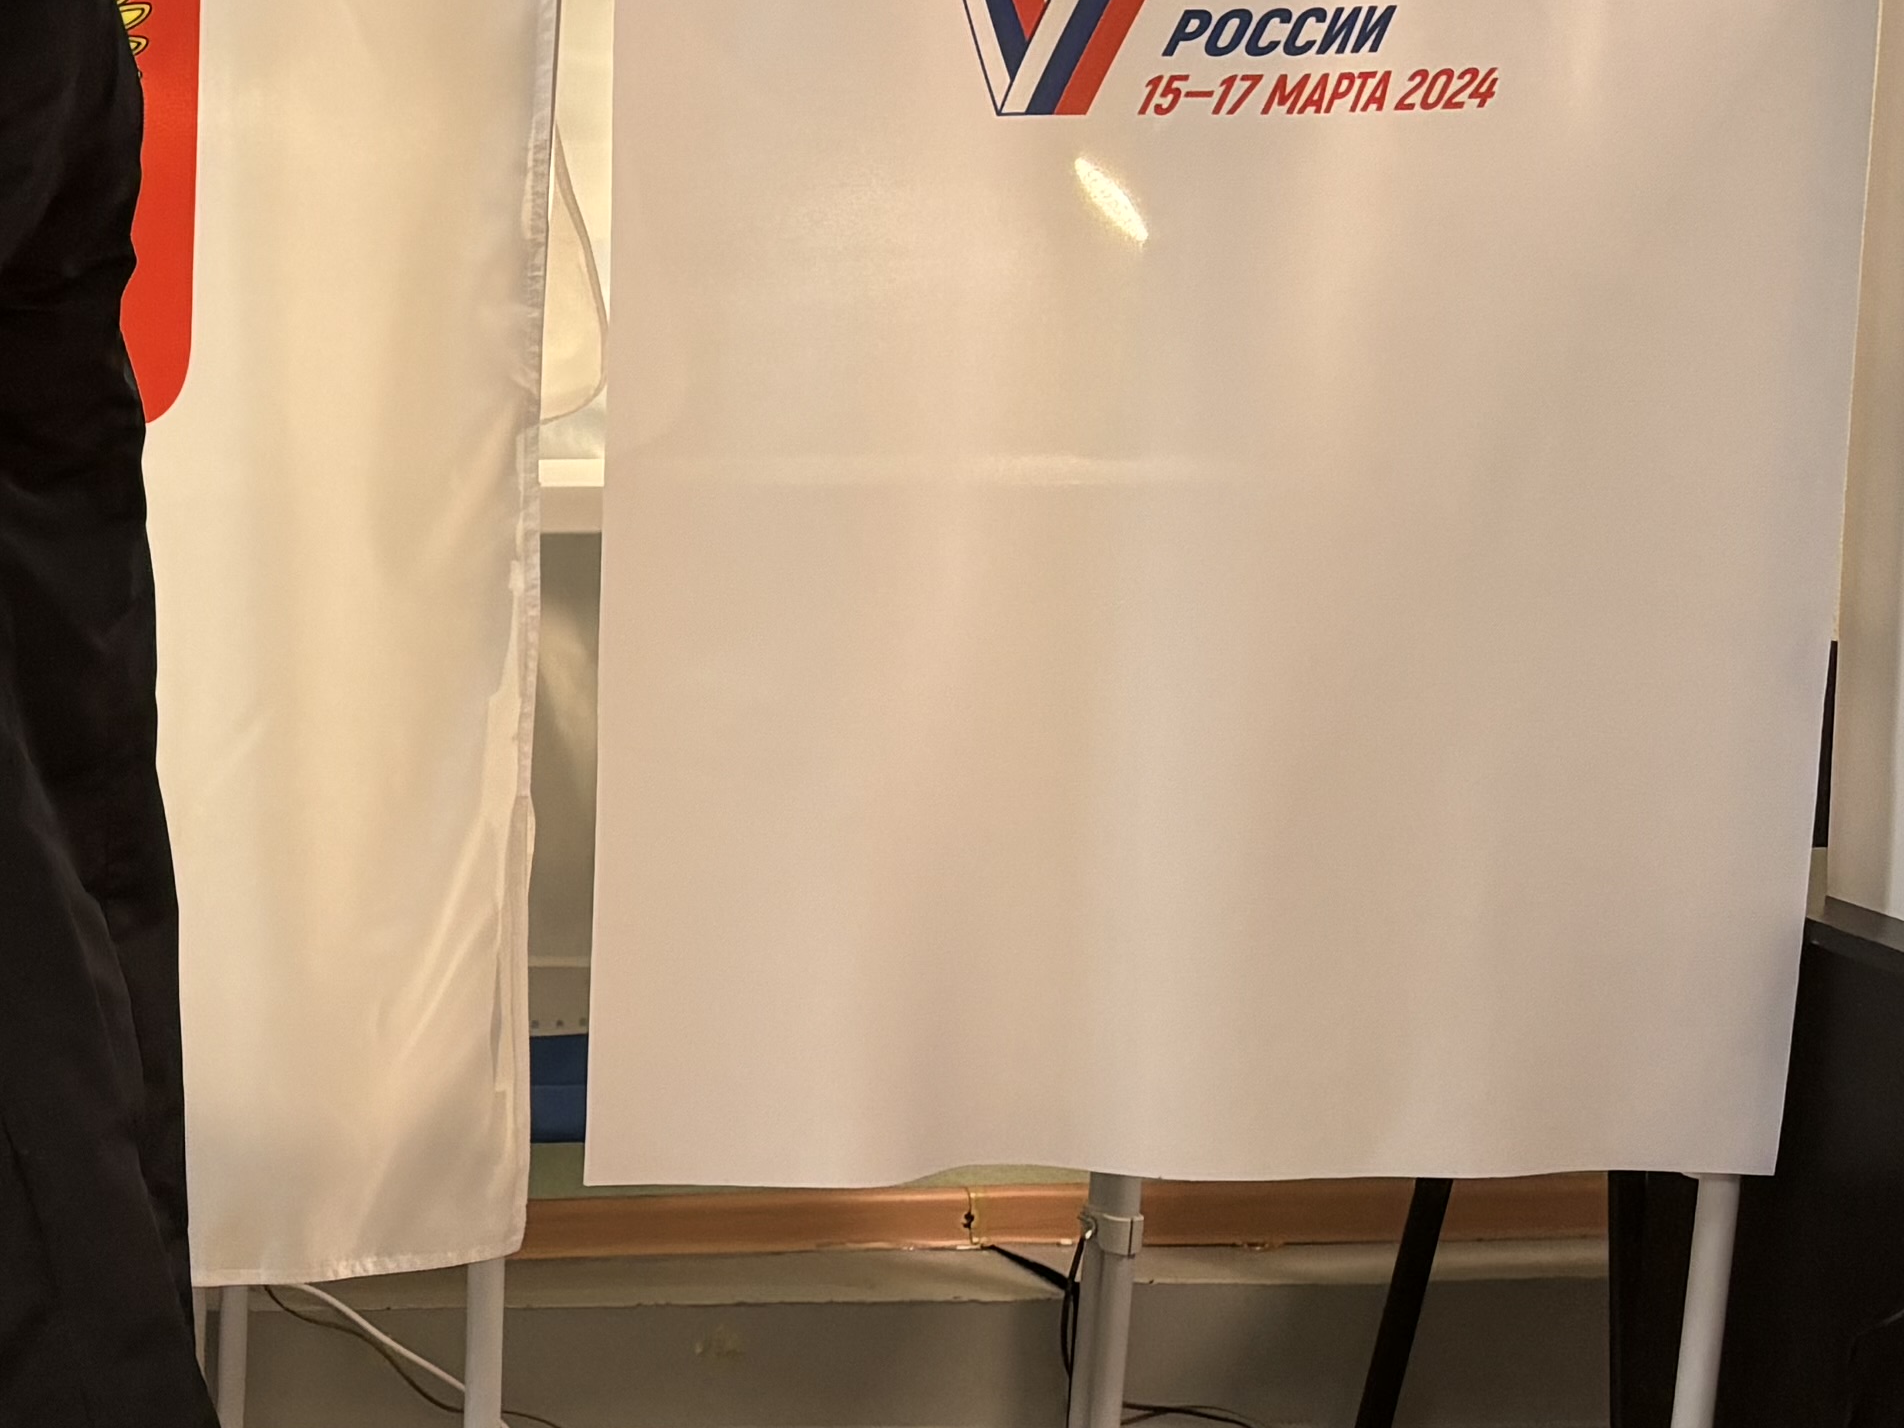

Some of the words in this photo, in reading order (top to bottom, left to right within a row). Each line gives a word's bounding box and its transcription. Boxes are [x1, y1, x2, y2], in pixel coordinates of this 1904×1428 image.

[1162, 6, 1397, 56] РОССИИ
[1260, 71, 1391, 114] МАРТА
[1394, 68, 1498, 110] 2024
